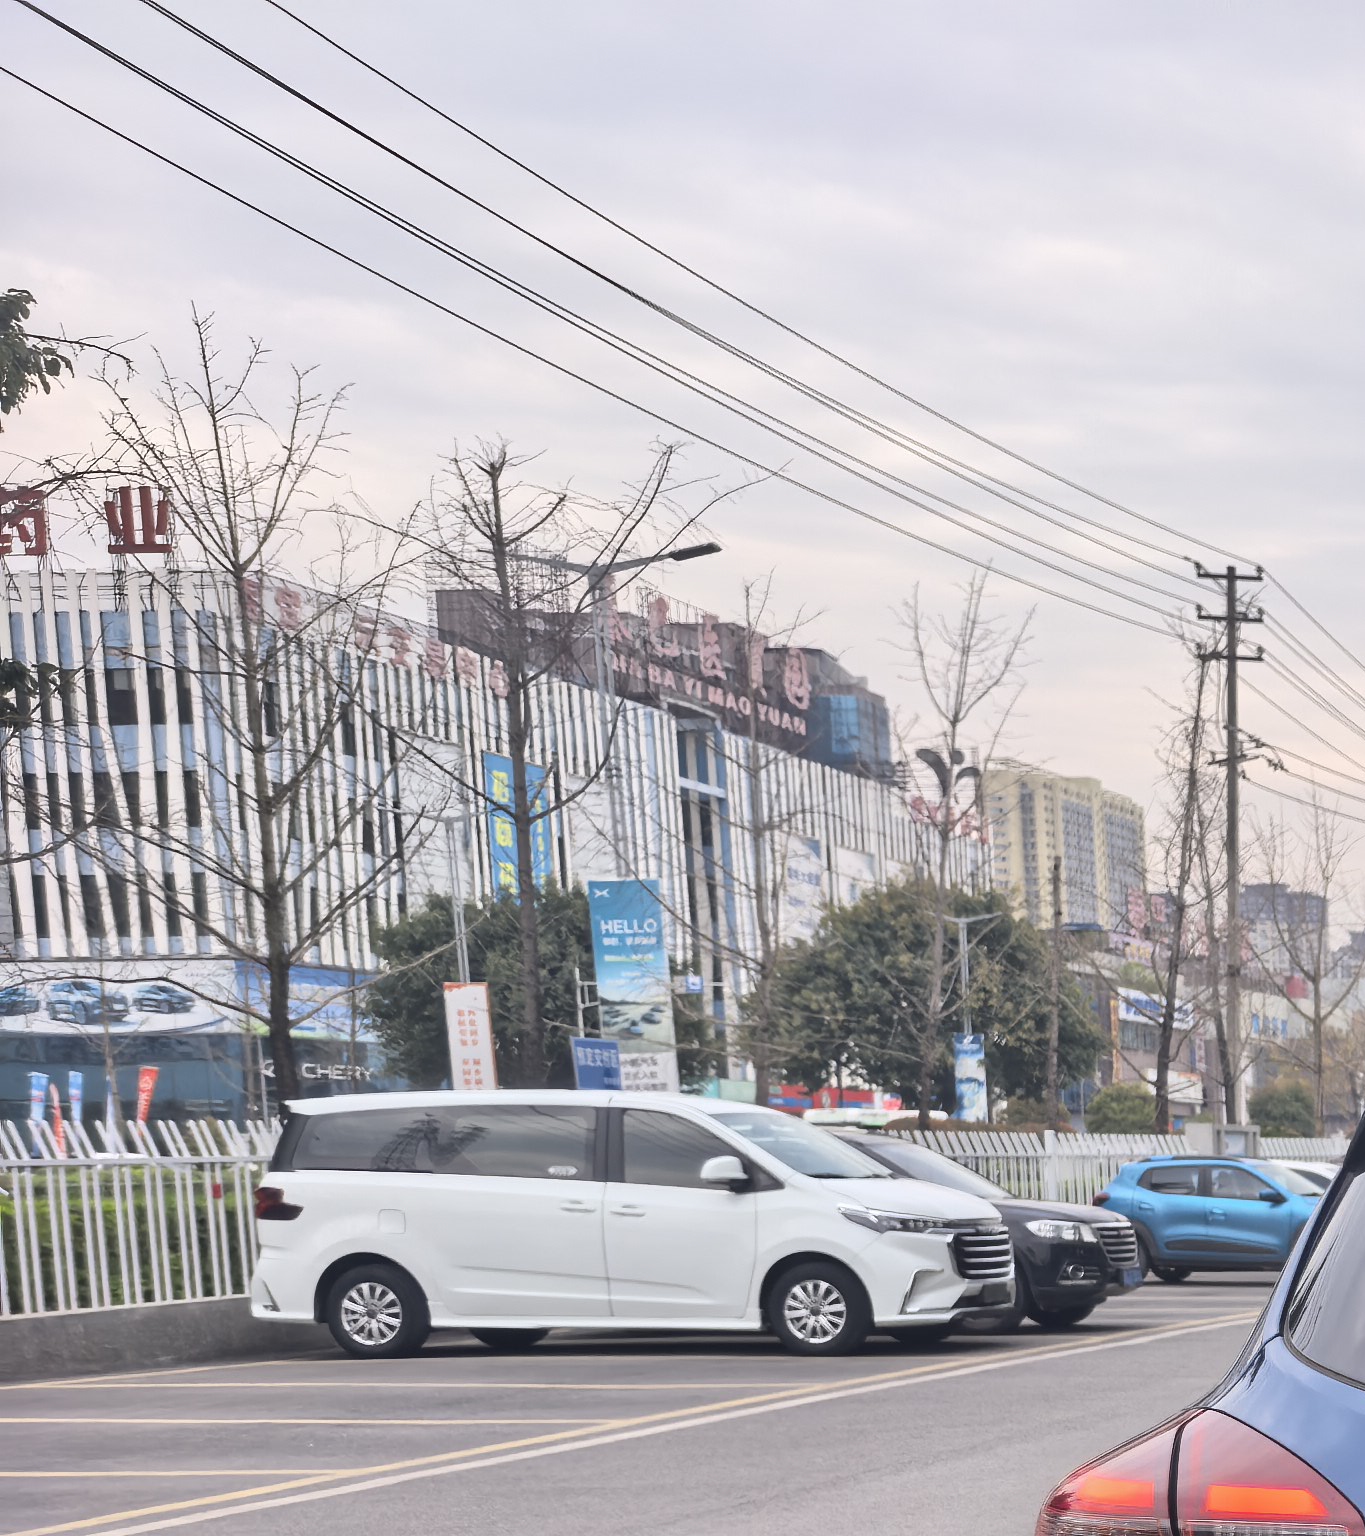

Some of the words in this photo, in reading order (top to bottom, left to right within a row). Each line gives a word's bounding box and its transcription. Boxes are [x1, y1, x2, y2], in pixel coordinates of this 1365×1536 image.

[647, 661, 678, 691] BA
[756, 701, 807, 736] YUAN
[601, 918, 658, 935] HELLO
